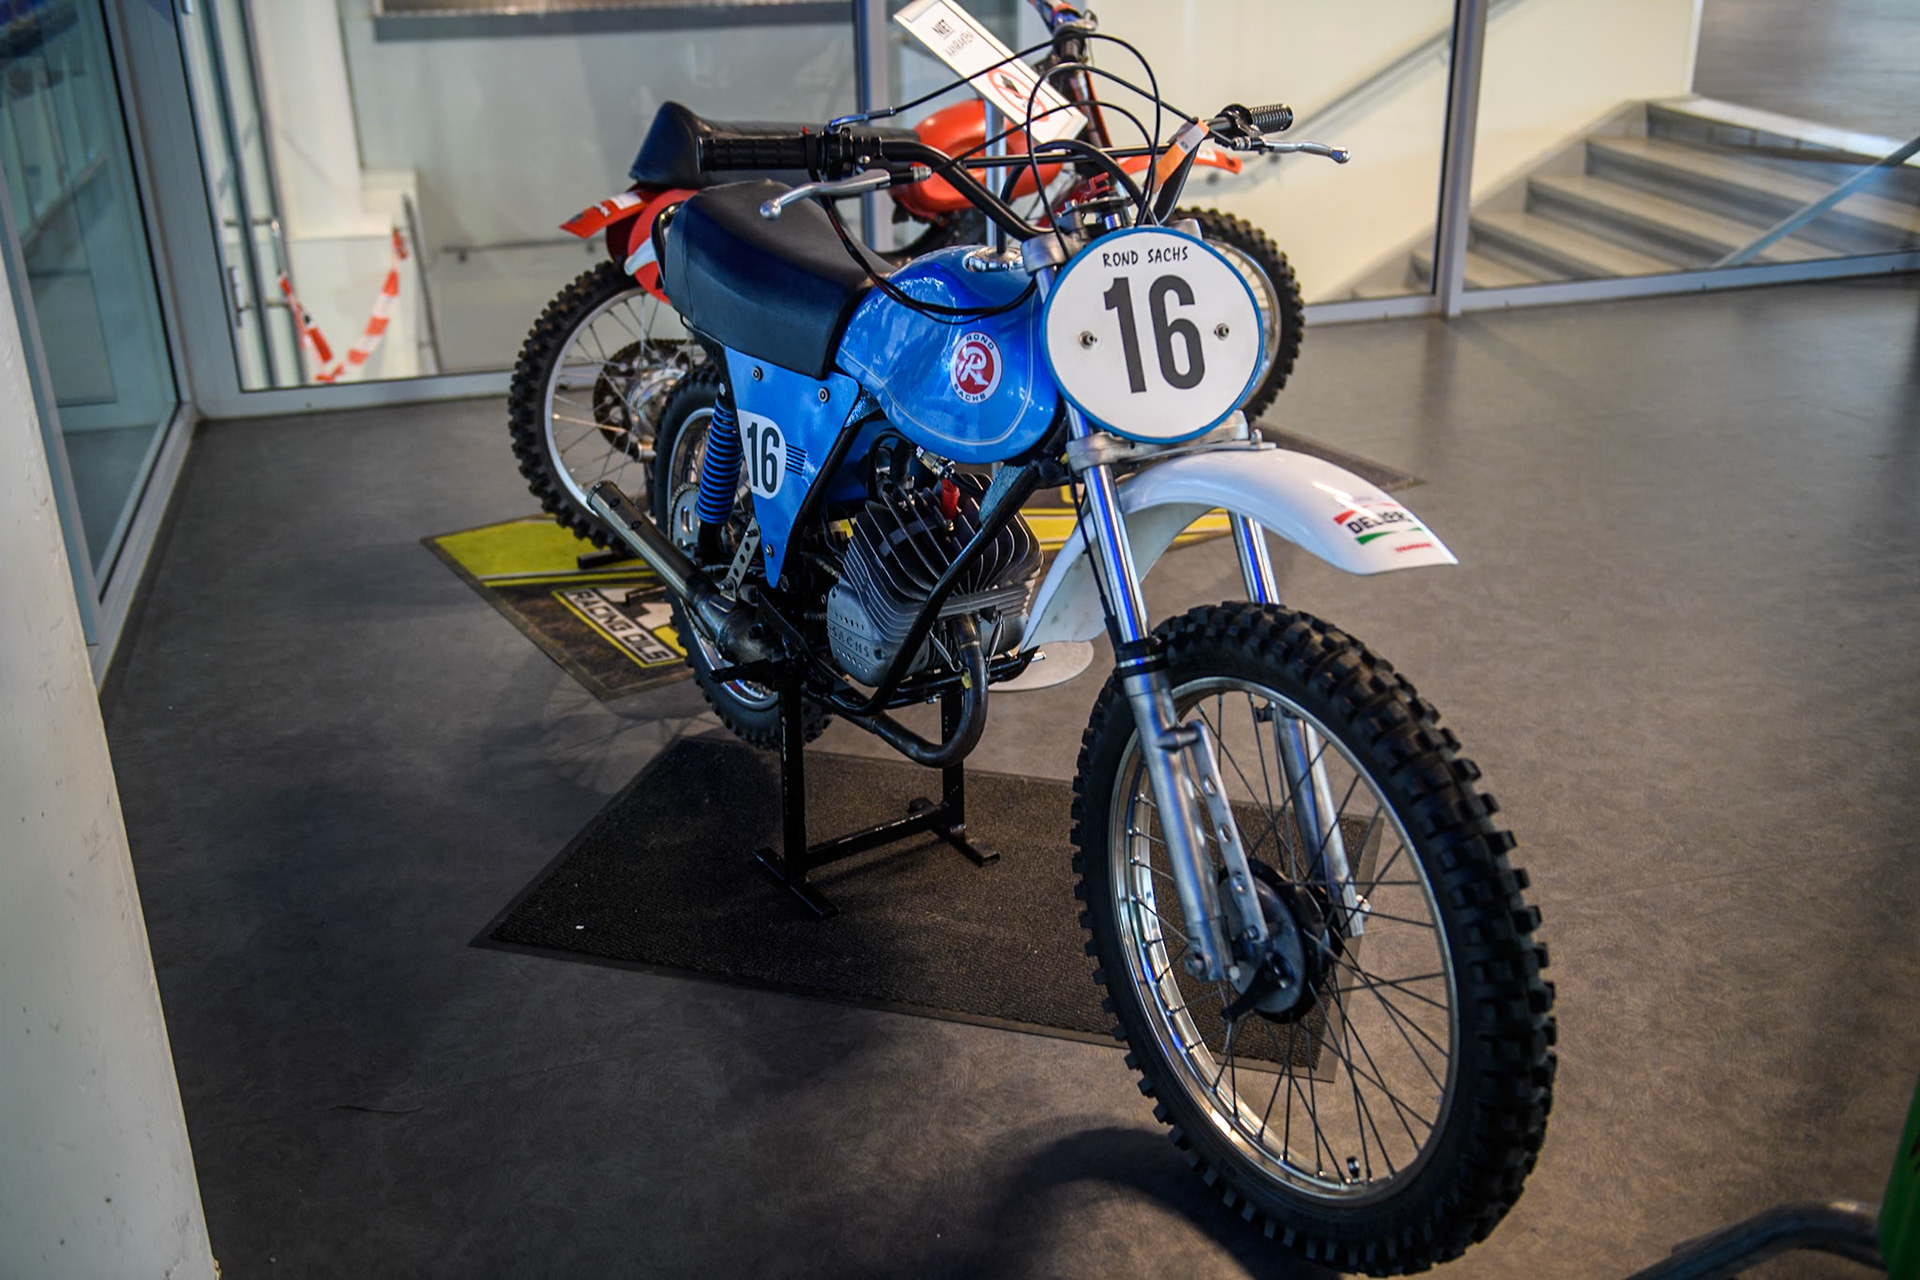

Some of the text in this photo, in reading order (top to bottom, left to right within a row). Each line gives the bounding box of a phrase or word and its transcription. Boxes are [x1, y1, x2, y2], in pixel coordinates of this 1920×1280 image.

[1102, 246, 1189, 268] ROND SACHS
[966, 333, 995, 351] ROND
[1103, 274, 1205, 394] 16
[953, 383, 986, 402] SACHS
[746, 421, 780, 494] 16
[570, 589, 671, 661] RACING OILS
[829, 626, 870, 658] SACHS
